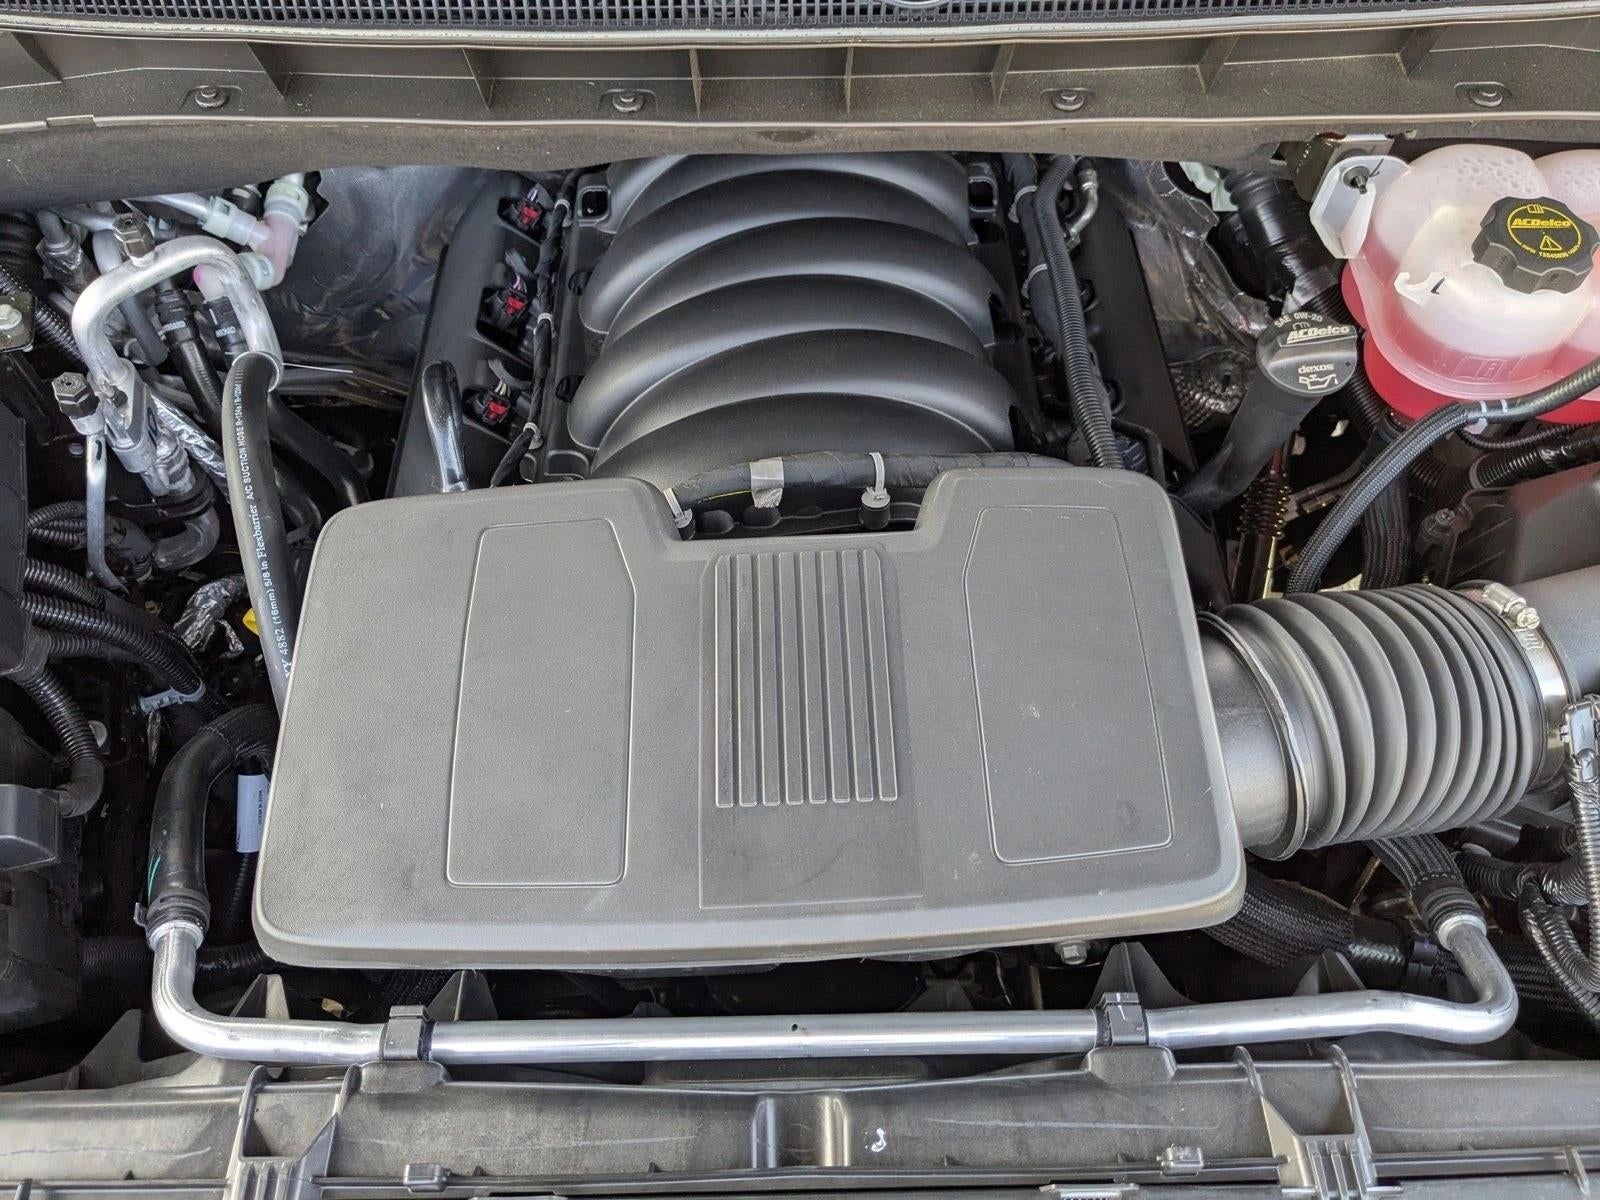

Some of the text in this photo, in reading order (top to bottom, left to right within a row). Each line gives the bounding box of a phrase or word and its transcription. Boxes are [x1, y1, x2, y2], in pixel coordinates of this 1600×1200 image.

[1511, 218, 1571, 228] ACDelco
[1274, 311, 1324, 328] SAE 0W-20
[1286, 325, 1350, 342] ACDelco
[1297, 363, 1335, 374] dexos
[236, 426, 246, 446] HOSE
[239, 447, 252, 484] SUCTION
[244, 485, 255, 500] A/C
[248, 504, 268, 559] Flexbarrier
[262, 571, 273, 587] 5/8
[266, 588, 282, 625] (16mm)
[275, 627, 289, 655] 4882
